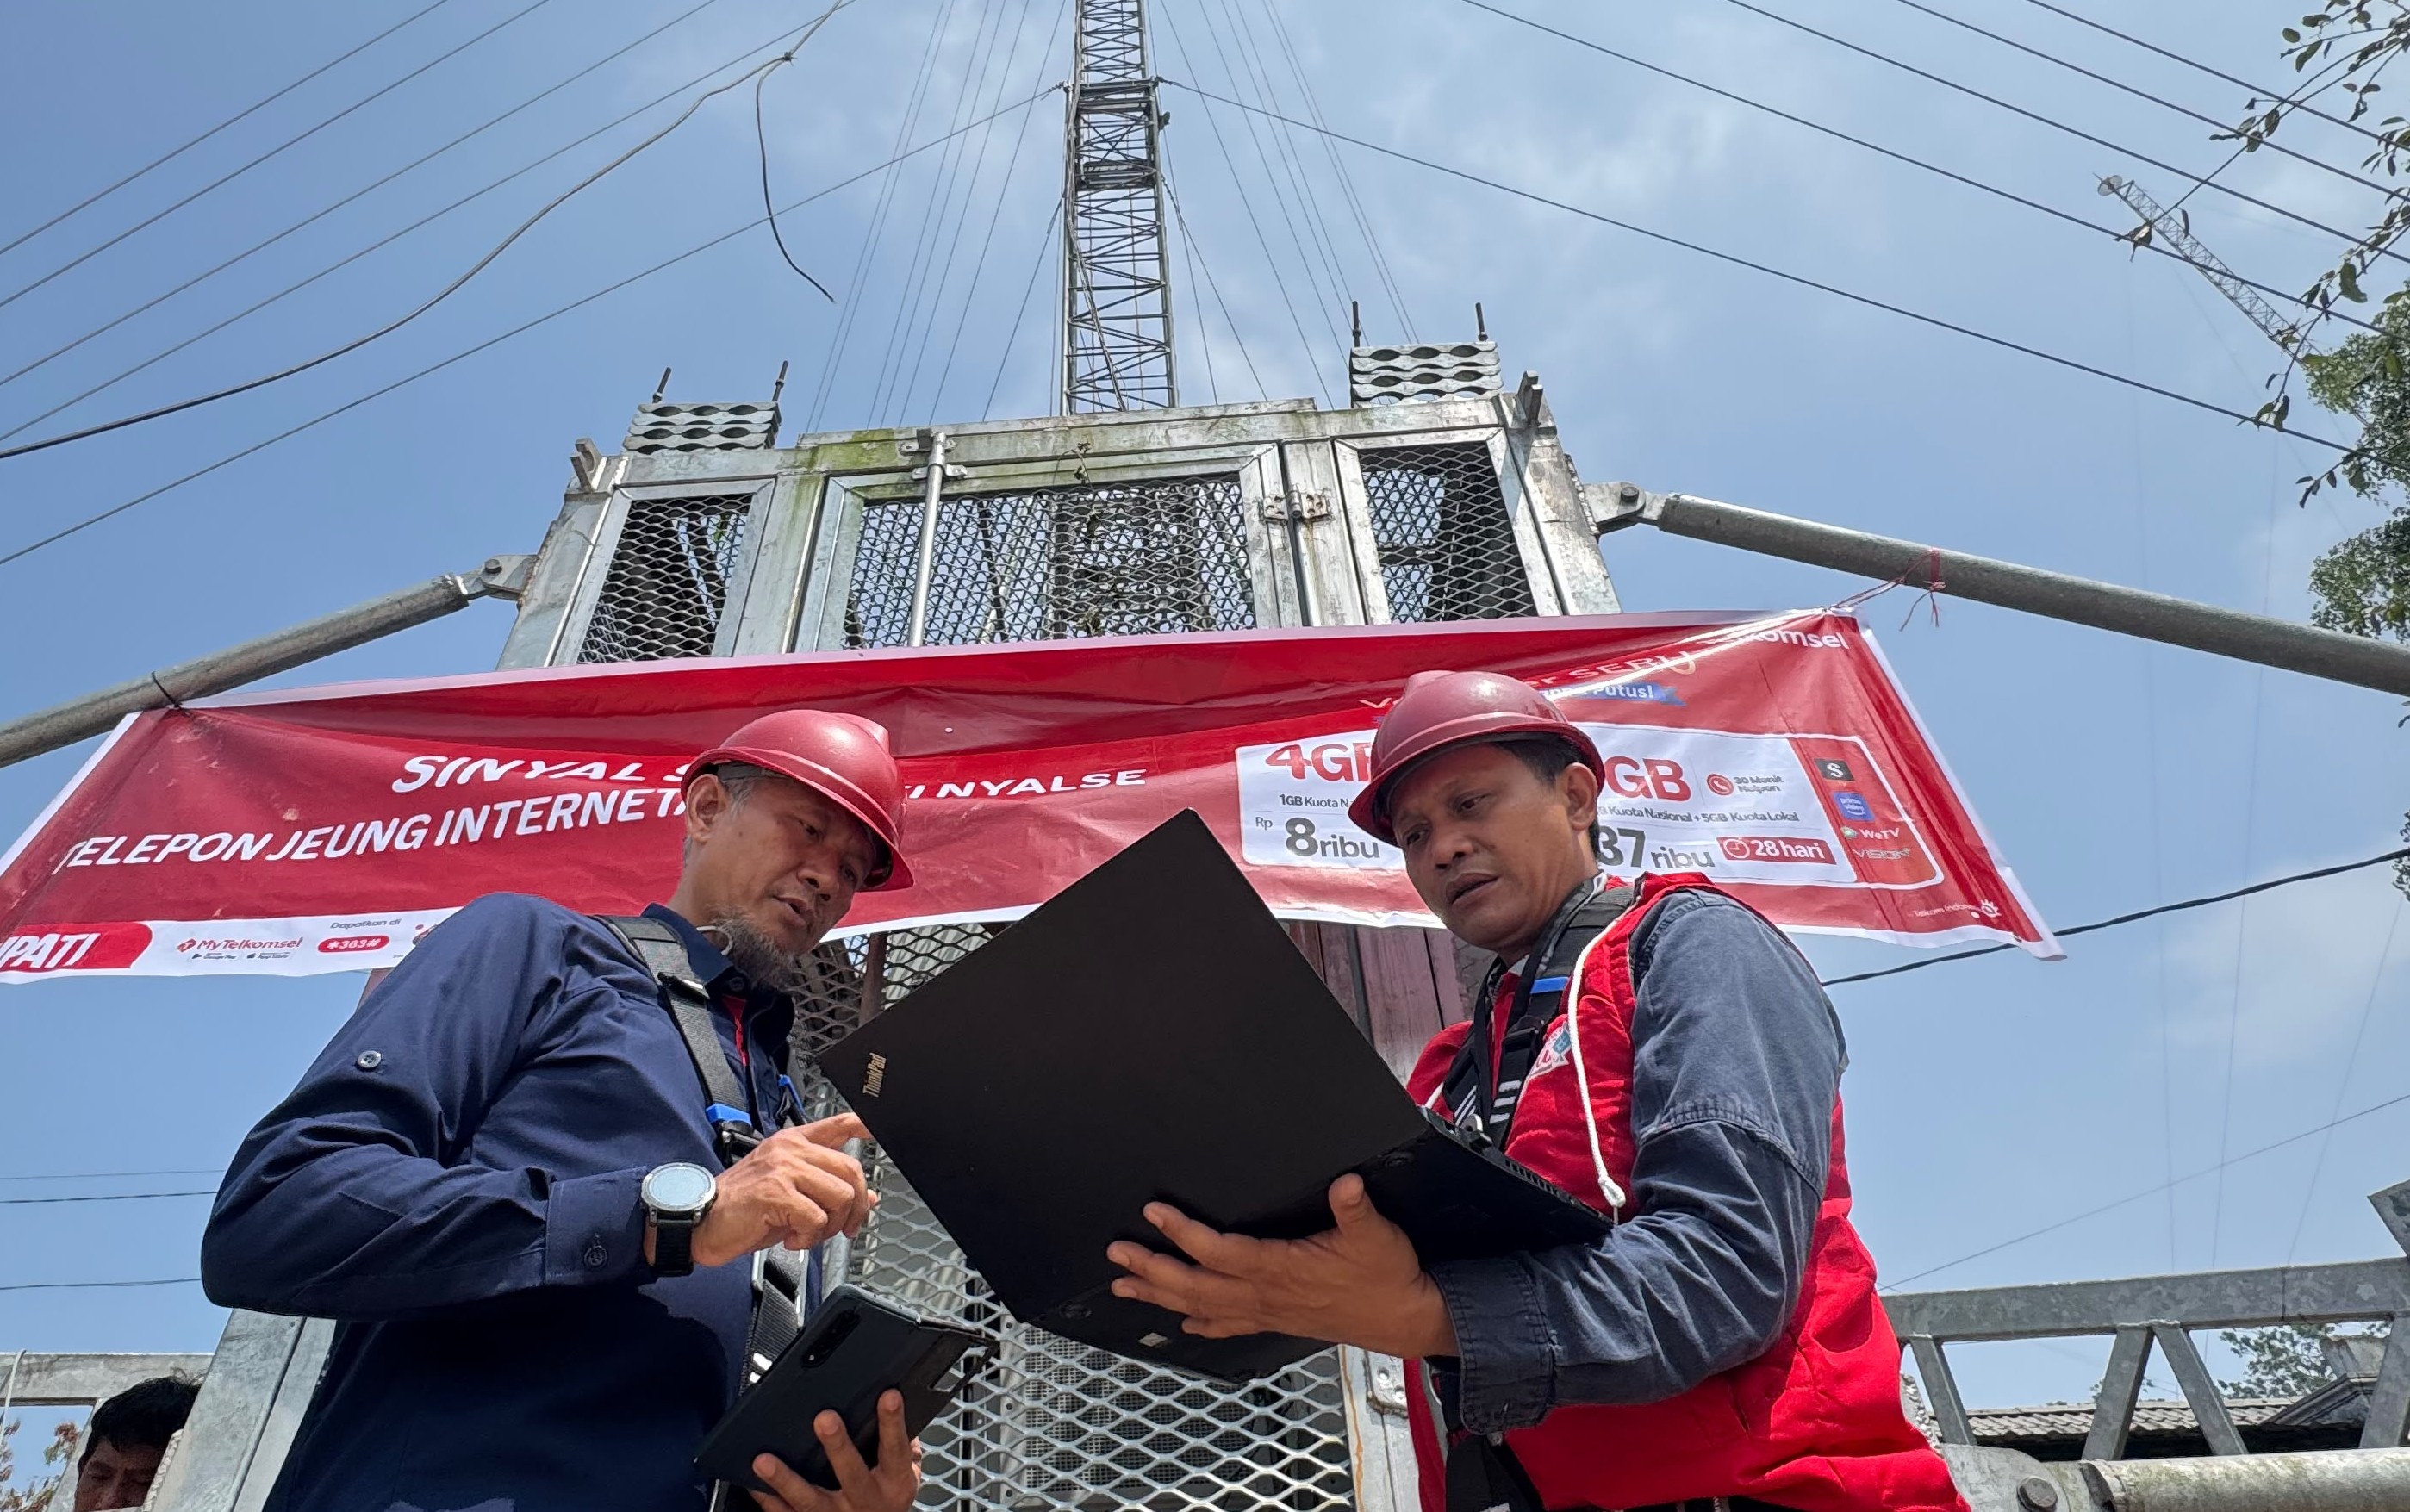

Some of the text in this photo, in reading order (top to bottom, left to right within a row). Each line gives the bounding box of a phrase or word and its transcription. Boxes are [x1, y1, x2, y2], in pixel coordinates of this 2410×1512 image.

[391, 755, 645, 793] SINYAL
[936, 768, 1147, 799] NYALSE
[1279, 793, 1303, 806] 1GB
[1305, 796, 1339, 808] Kuota
[1255, 816, 1274, 831] Rp
[1608, 806, 1645, 818] Kuota
[1644, 807, 1693, 823] Nasional
[1729, 812, 1767, 822] Kuota
[1767, 812, 1800, 822] Lokal
[265, 813, 432, 861] JEUNG
[1859, 828, 1900, 840] WeTV
[1650, 846, 1716, 868] ribu
[1753, 839, 1825, 859] 28 hari
[862, 1052, 887, 1098] ThinkPad
